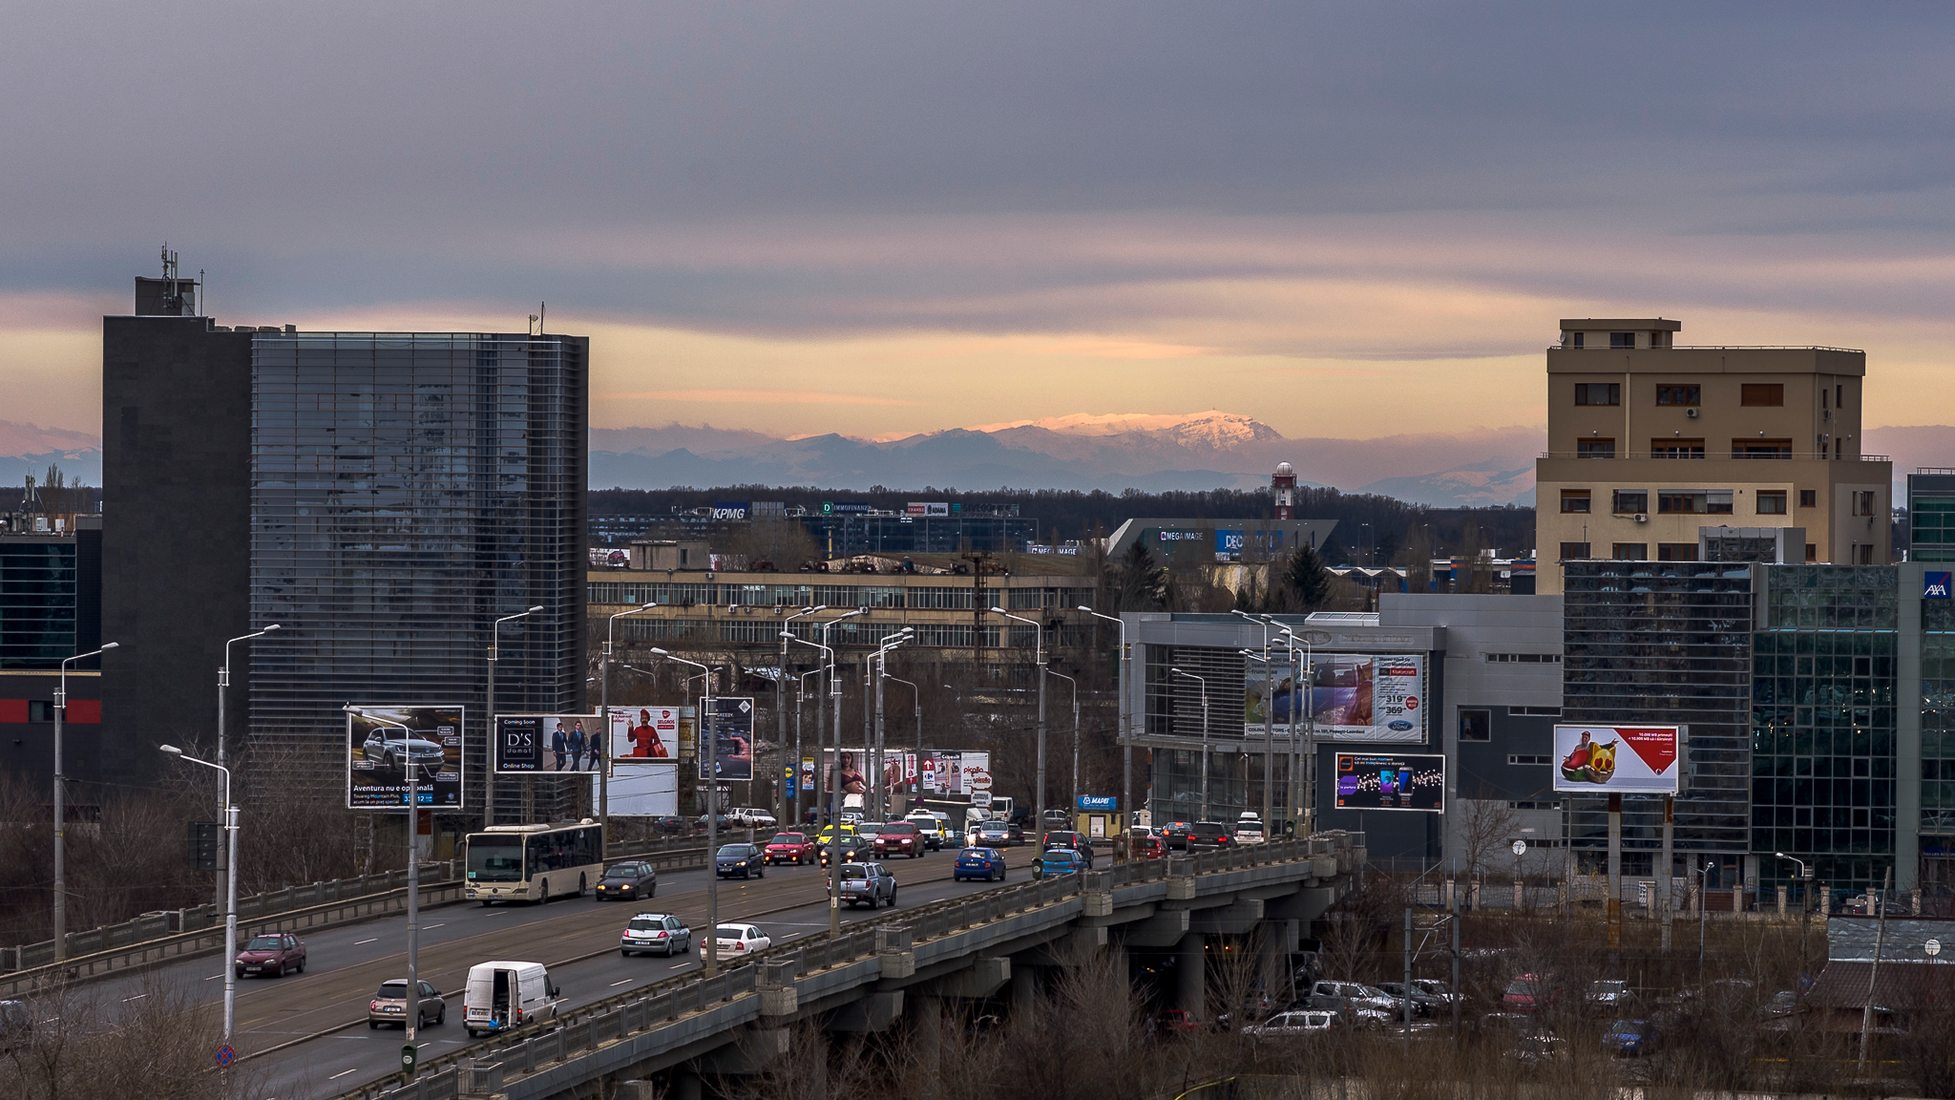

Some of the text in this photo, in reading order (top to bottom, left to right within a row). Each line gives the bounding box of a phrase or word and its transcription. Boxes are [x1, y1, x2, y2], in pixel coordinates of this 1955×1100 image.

[712, 508, 746, 520] KPMG
[1167, 532, 1203, 541] MEGA IMAGE
[1924, 584, 1946, 596] AXA
[1386, 695, 1403, 703] 319
[1386, 706, 1403, 714] 369
[353, 784, 385, 792] Aventura
